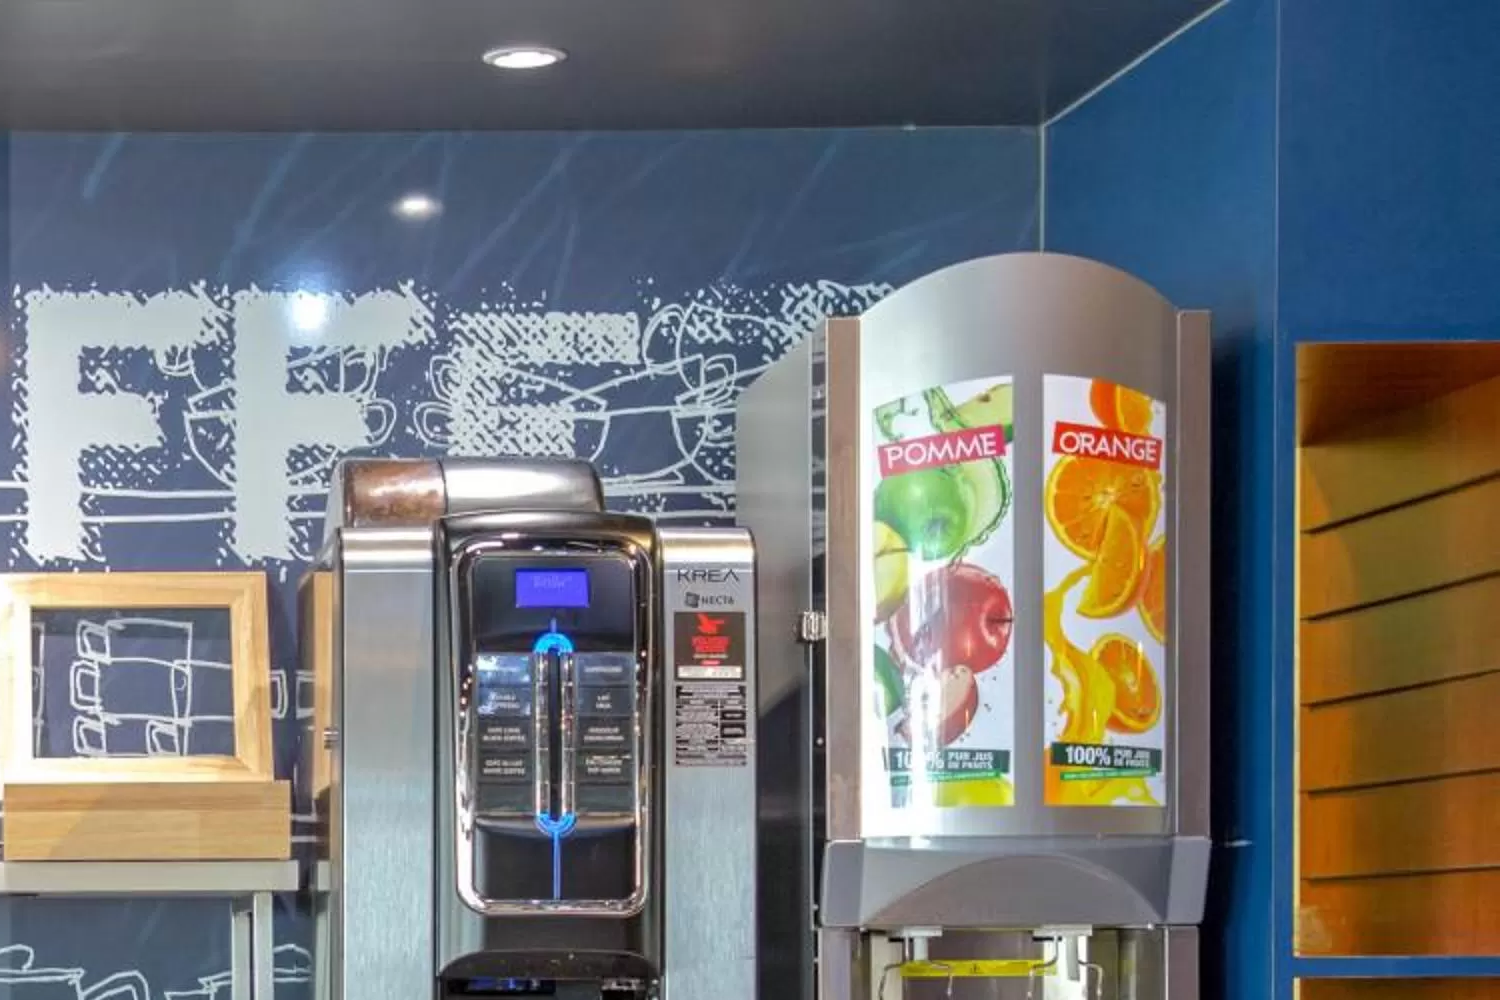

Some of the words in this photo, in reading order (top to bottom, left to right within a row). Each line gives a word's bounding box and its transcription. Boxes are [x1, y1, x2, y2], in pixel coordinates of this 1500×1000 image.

[885, 431, 997, 468] POMME
[1059, 431, 1158, 464] ORANGE
[677, 568, 740, 583] KREA
[1065, 746, 1111, 766] 100%
